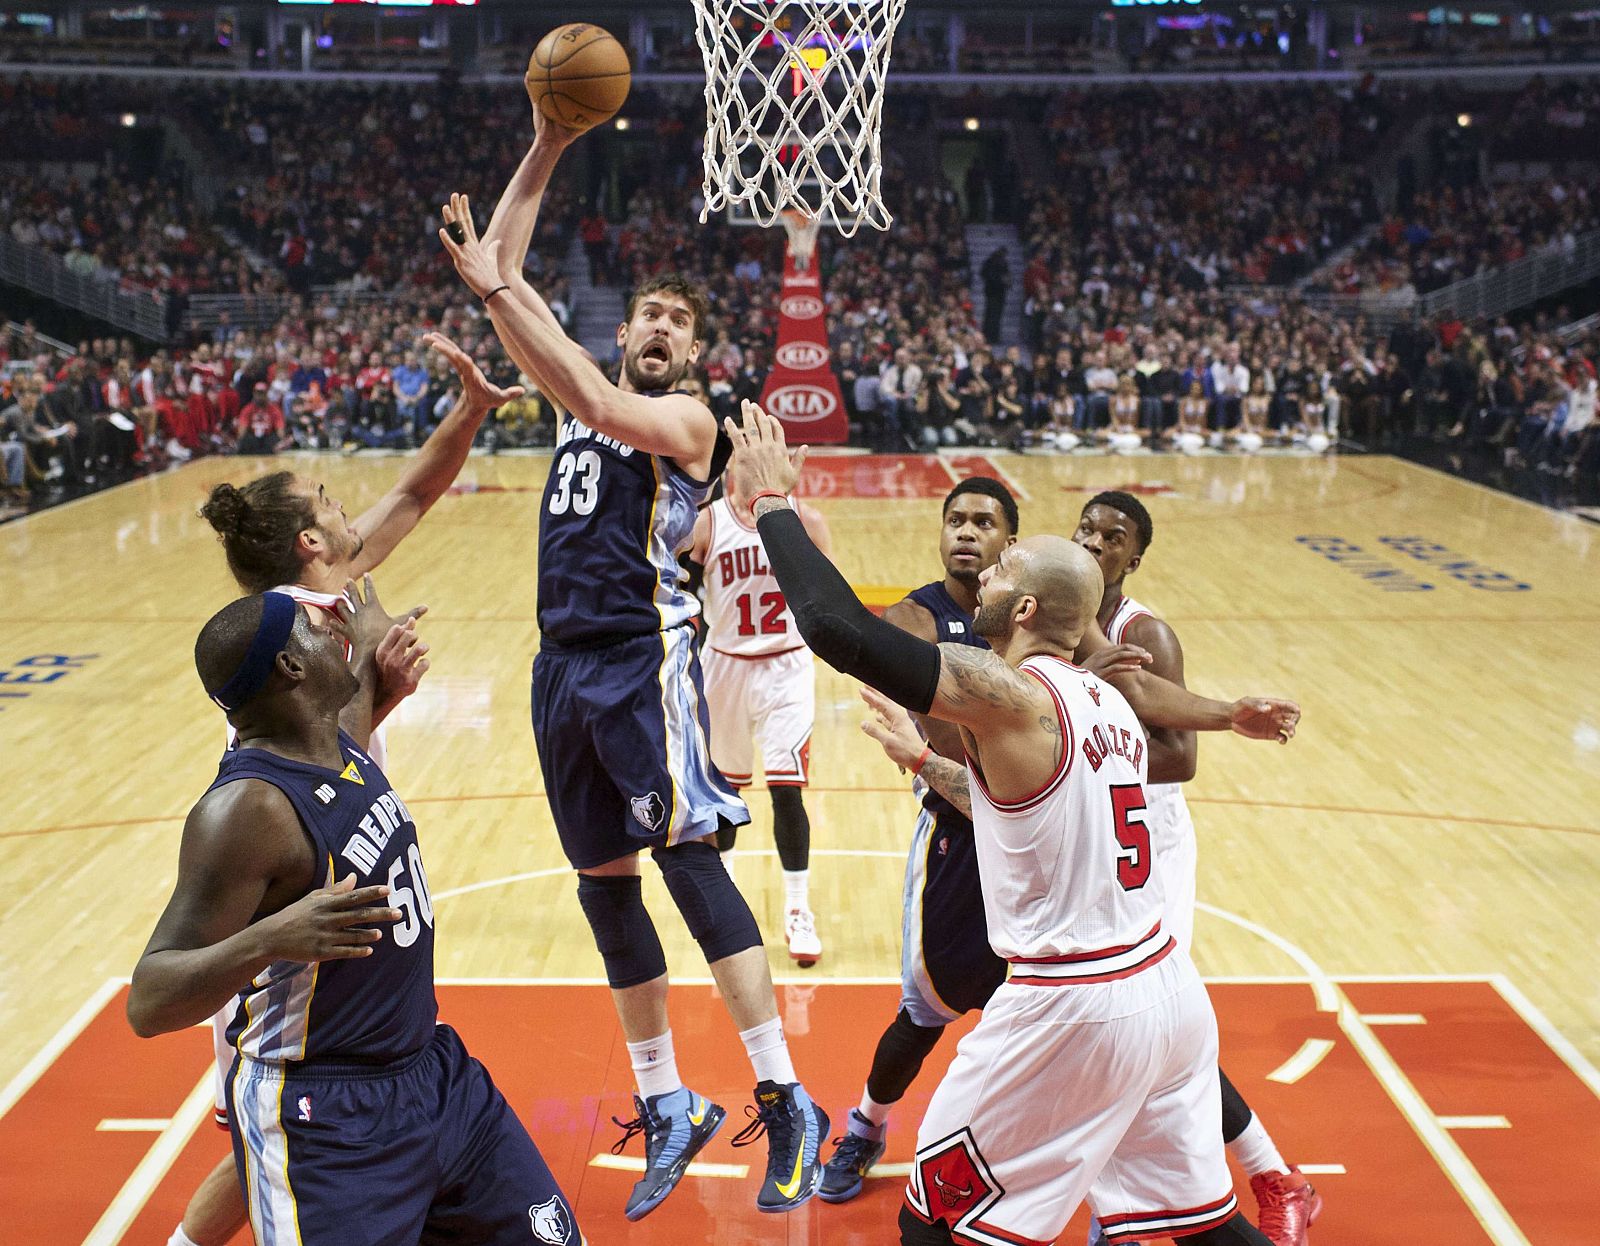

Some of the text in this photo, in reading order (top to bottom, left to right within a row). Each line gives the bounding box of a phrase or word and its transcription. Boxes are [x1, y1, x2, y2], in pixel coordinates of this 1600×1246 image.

[784, 350, 820, 363] KIA
[778, 392, 825, 414] KIA
[548, 450, 602, 516] 33
[718, 545, 776, 588] BUL
[736, 591, 787, 636] 12
[1108, 783, 1152, 892] 5
[387, 842, 434, 948] 50
